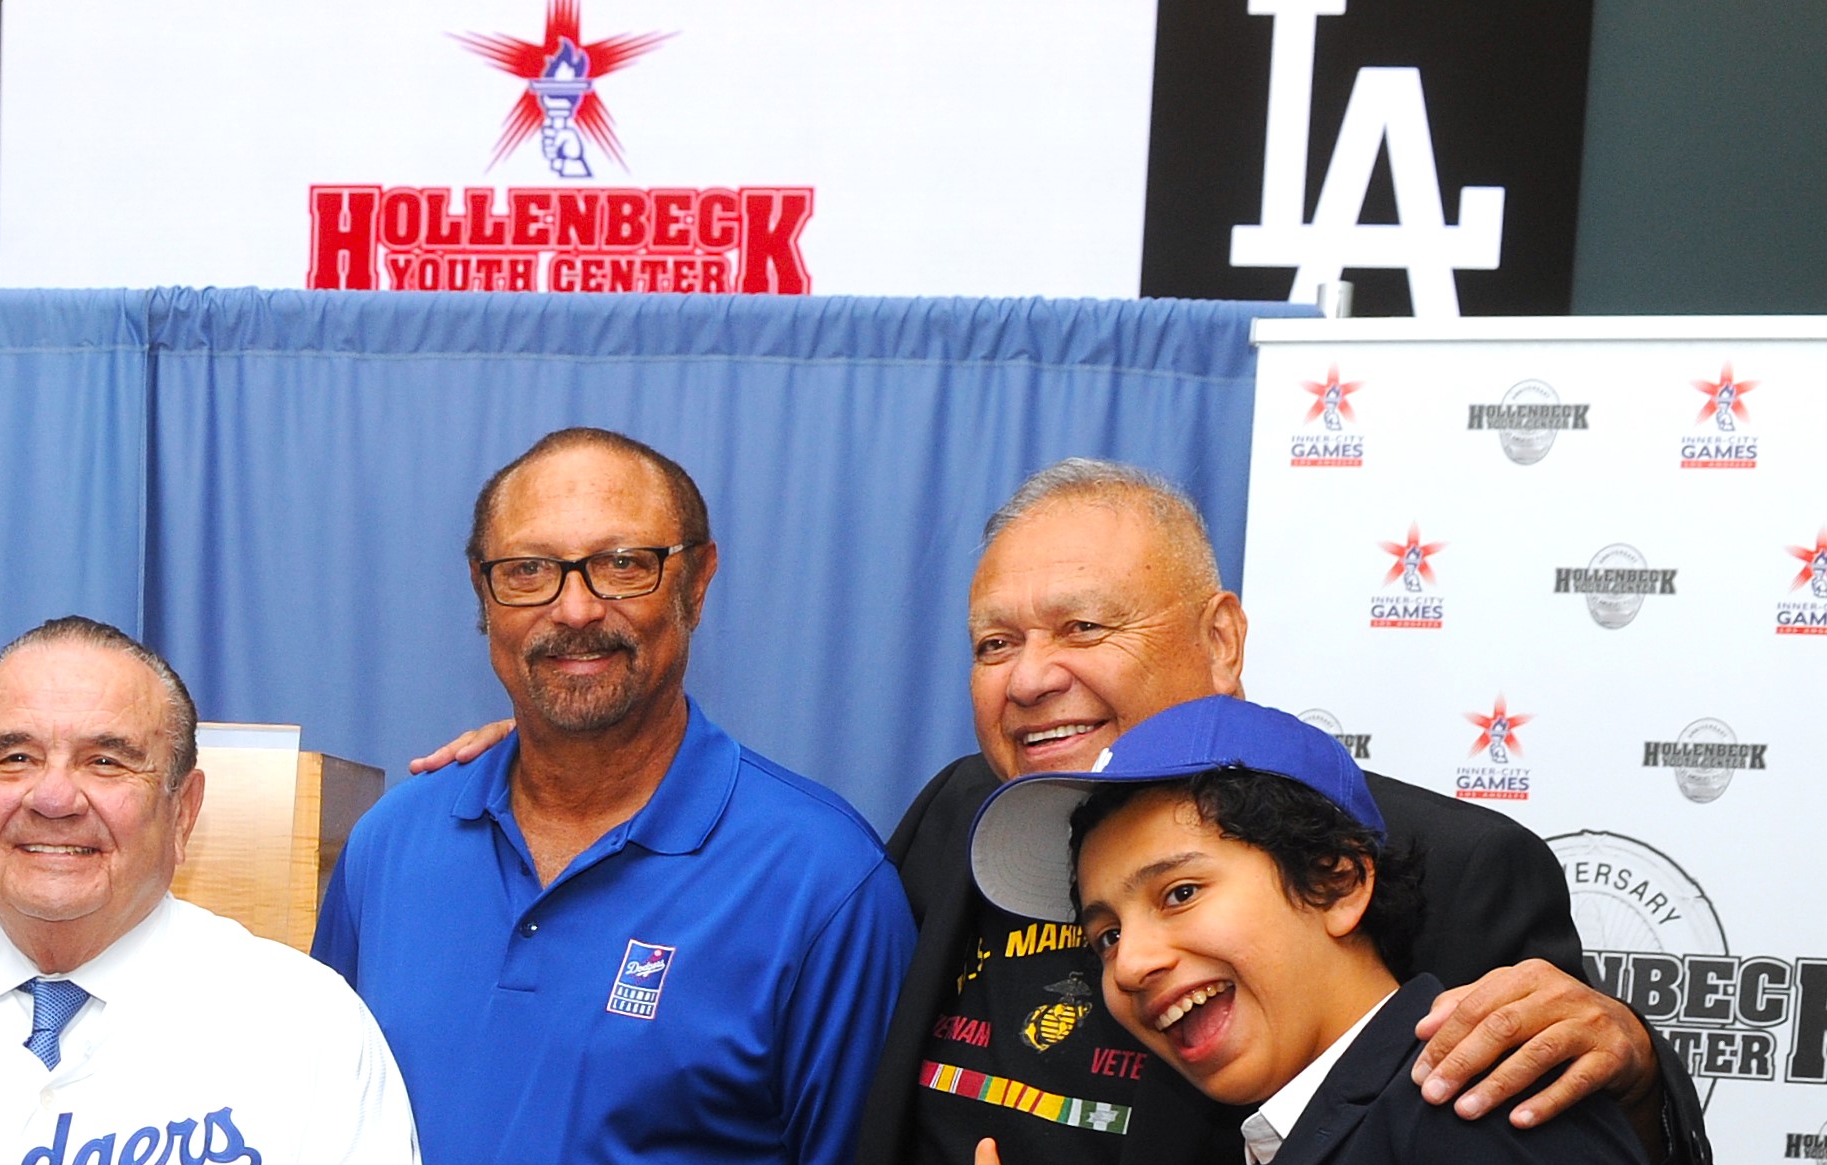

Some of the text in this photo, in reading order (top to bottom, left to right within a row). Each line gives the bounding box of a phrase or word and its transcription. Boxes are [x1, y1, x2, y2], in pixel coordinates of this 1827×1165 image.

[1230, 0, 1505, 317] LA
[307, 185, 815, 295] HOLLENBECK
[385, 252, 736, 294] YOUTH CENTER
[1467, 403, 1590, 430] HOLLENBECK
[1291, 443, 1363, 458] GAMES
[1681, 445, 1758, 459] GAMES
[1554, 568, 1678, 595] HOLLENBECK
[1371, 604, 1443, 619] GAMES
[1777, 602, 1827, 610] INNER-
[1777, 611, 1827, 625] GAM
[1642, 741, 1767, 769] HOLLENBECK
[1456, 776, 1529, 791] GAMES
[1564, 861, 1682, 926] ERSARY
[625, 959, 666, 978] Dodgers
[612, 998, 652, 1015] LEAGUE
[1583, 950, 1827, 1083] NBECK
[1090, 1047, 1148, 1081] VETE
[1661, 1027, 1776, 1081] TER
